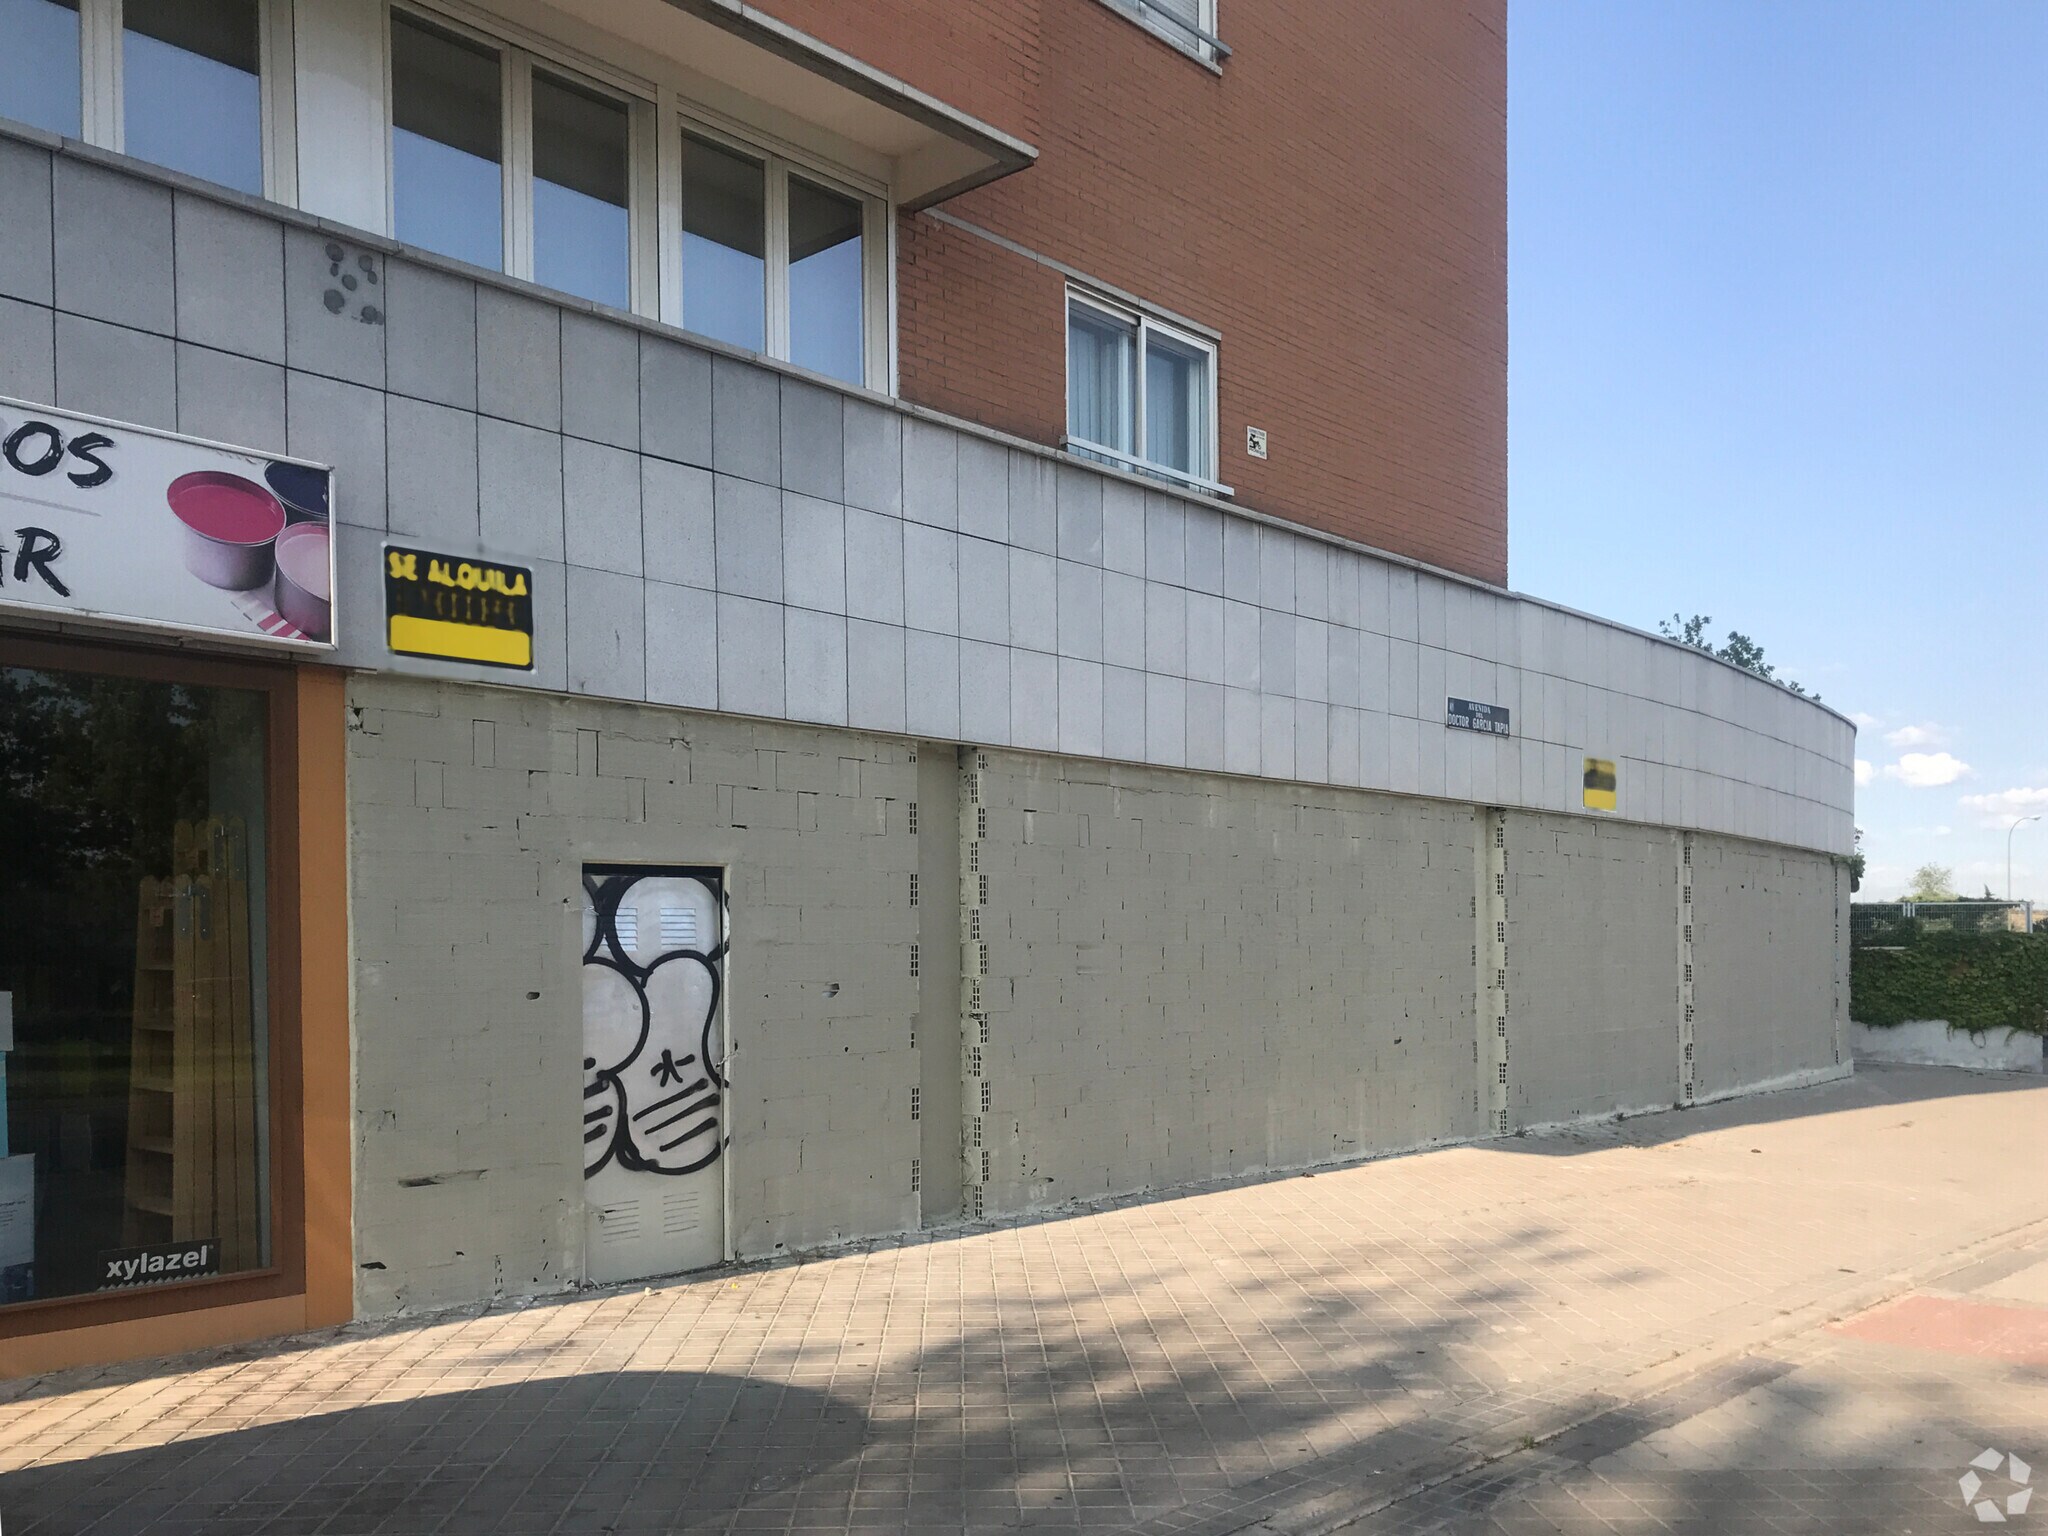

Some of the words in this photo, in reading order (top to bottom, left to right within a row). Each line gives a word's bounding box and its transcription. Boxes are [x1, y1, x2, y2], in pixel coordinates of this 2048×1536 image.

[0, 527, 71, 598] R
[1468, 703, 1491, 714] AVENIDA
[1448, 714, 1469, 727] DOCTOR
[1494, 721, 1508, 734] TAPIA
[106, 1245, 208, 1281] xylazel
